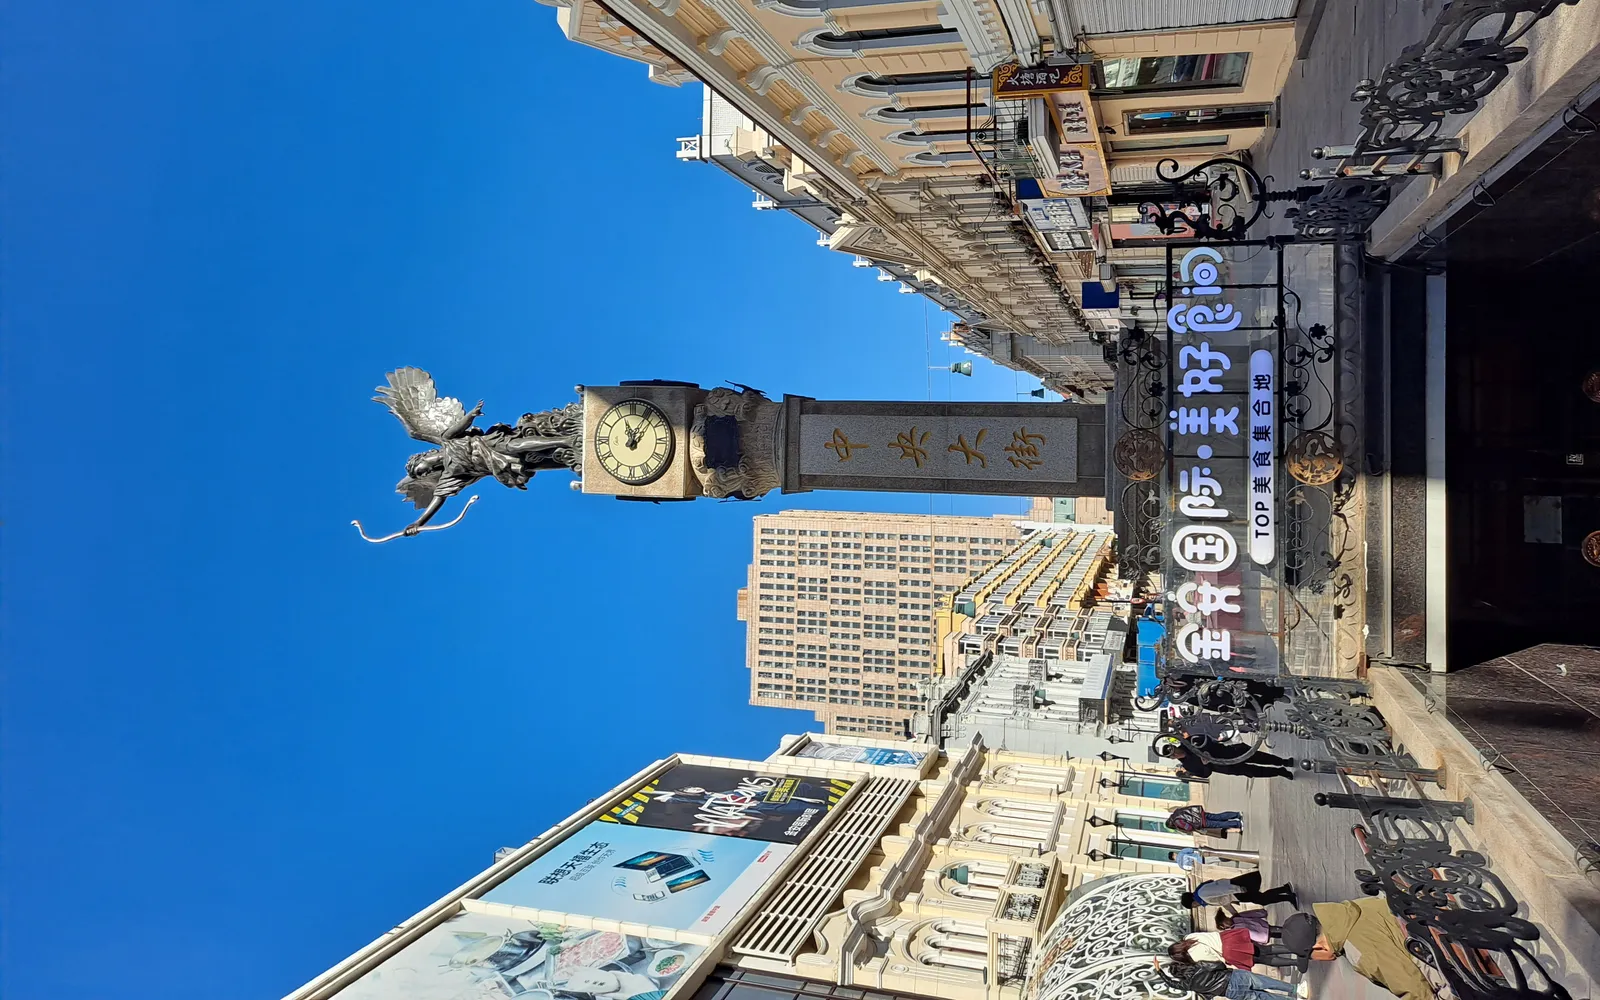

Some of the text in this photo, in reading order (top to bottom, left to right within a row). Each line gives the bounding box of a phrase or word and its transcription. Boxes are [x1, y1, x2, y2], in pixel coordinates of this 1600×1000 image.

[1006, 68, 1060, 86] 火塘酒吧
[824, 426, 1049, 470] 中央大街
[538, 842, 610, 886] 联想天禧生态
